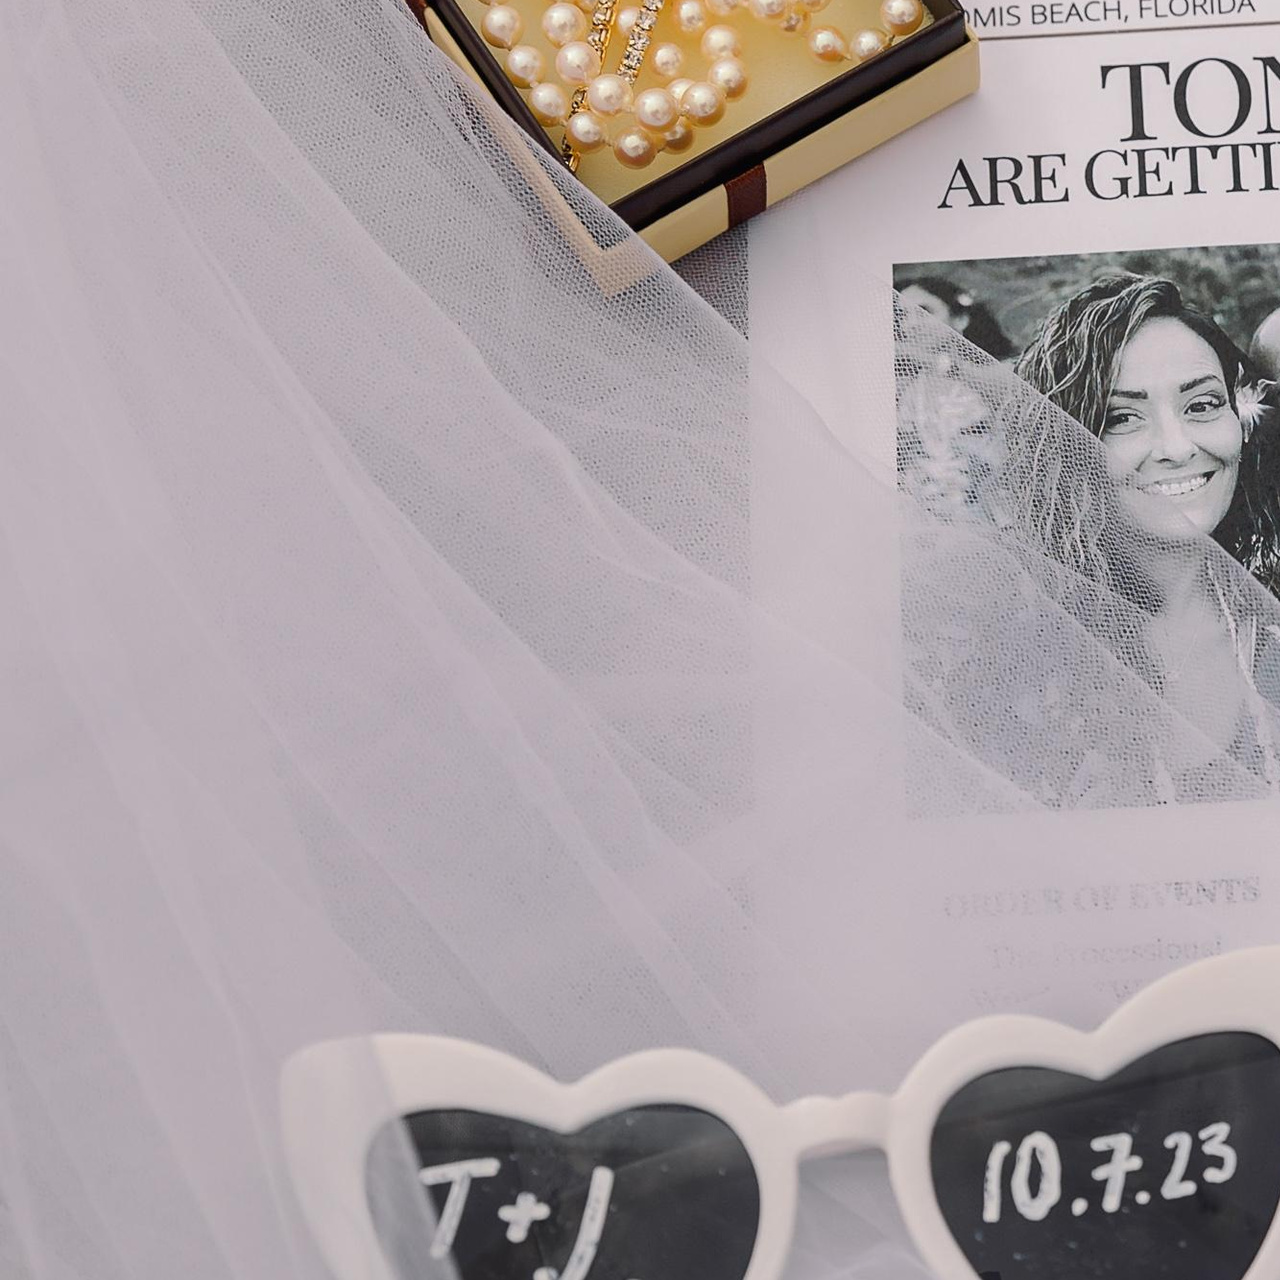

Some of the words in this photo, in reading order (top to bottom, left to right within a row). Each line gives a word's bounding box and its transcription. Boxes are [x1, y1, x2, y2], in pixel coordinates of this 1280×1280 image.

[1031, 0, 1128, 25] BEACH,
[937, 152, 1070, 209] ARE
[981, 1122, 1237, 1222] 10.7.23
